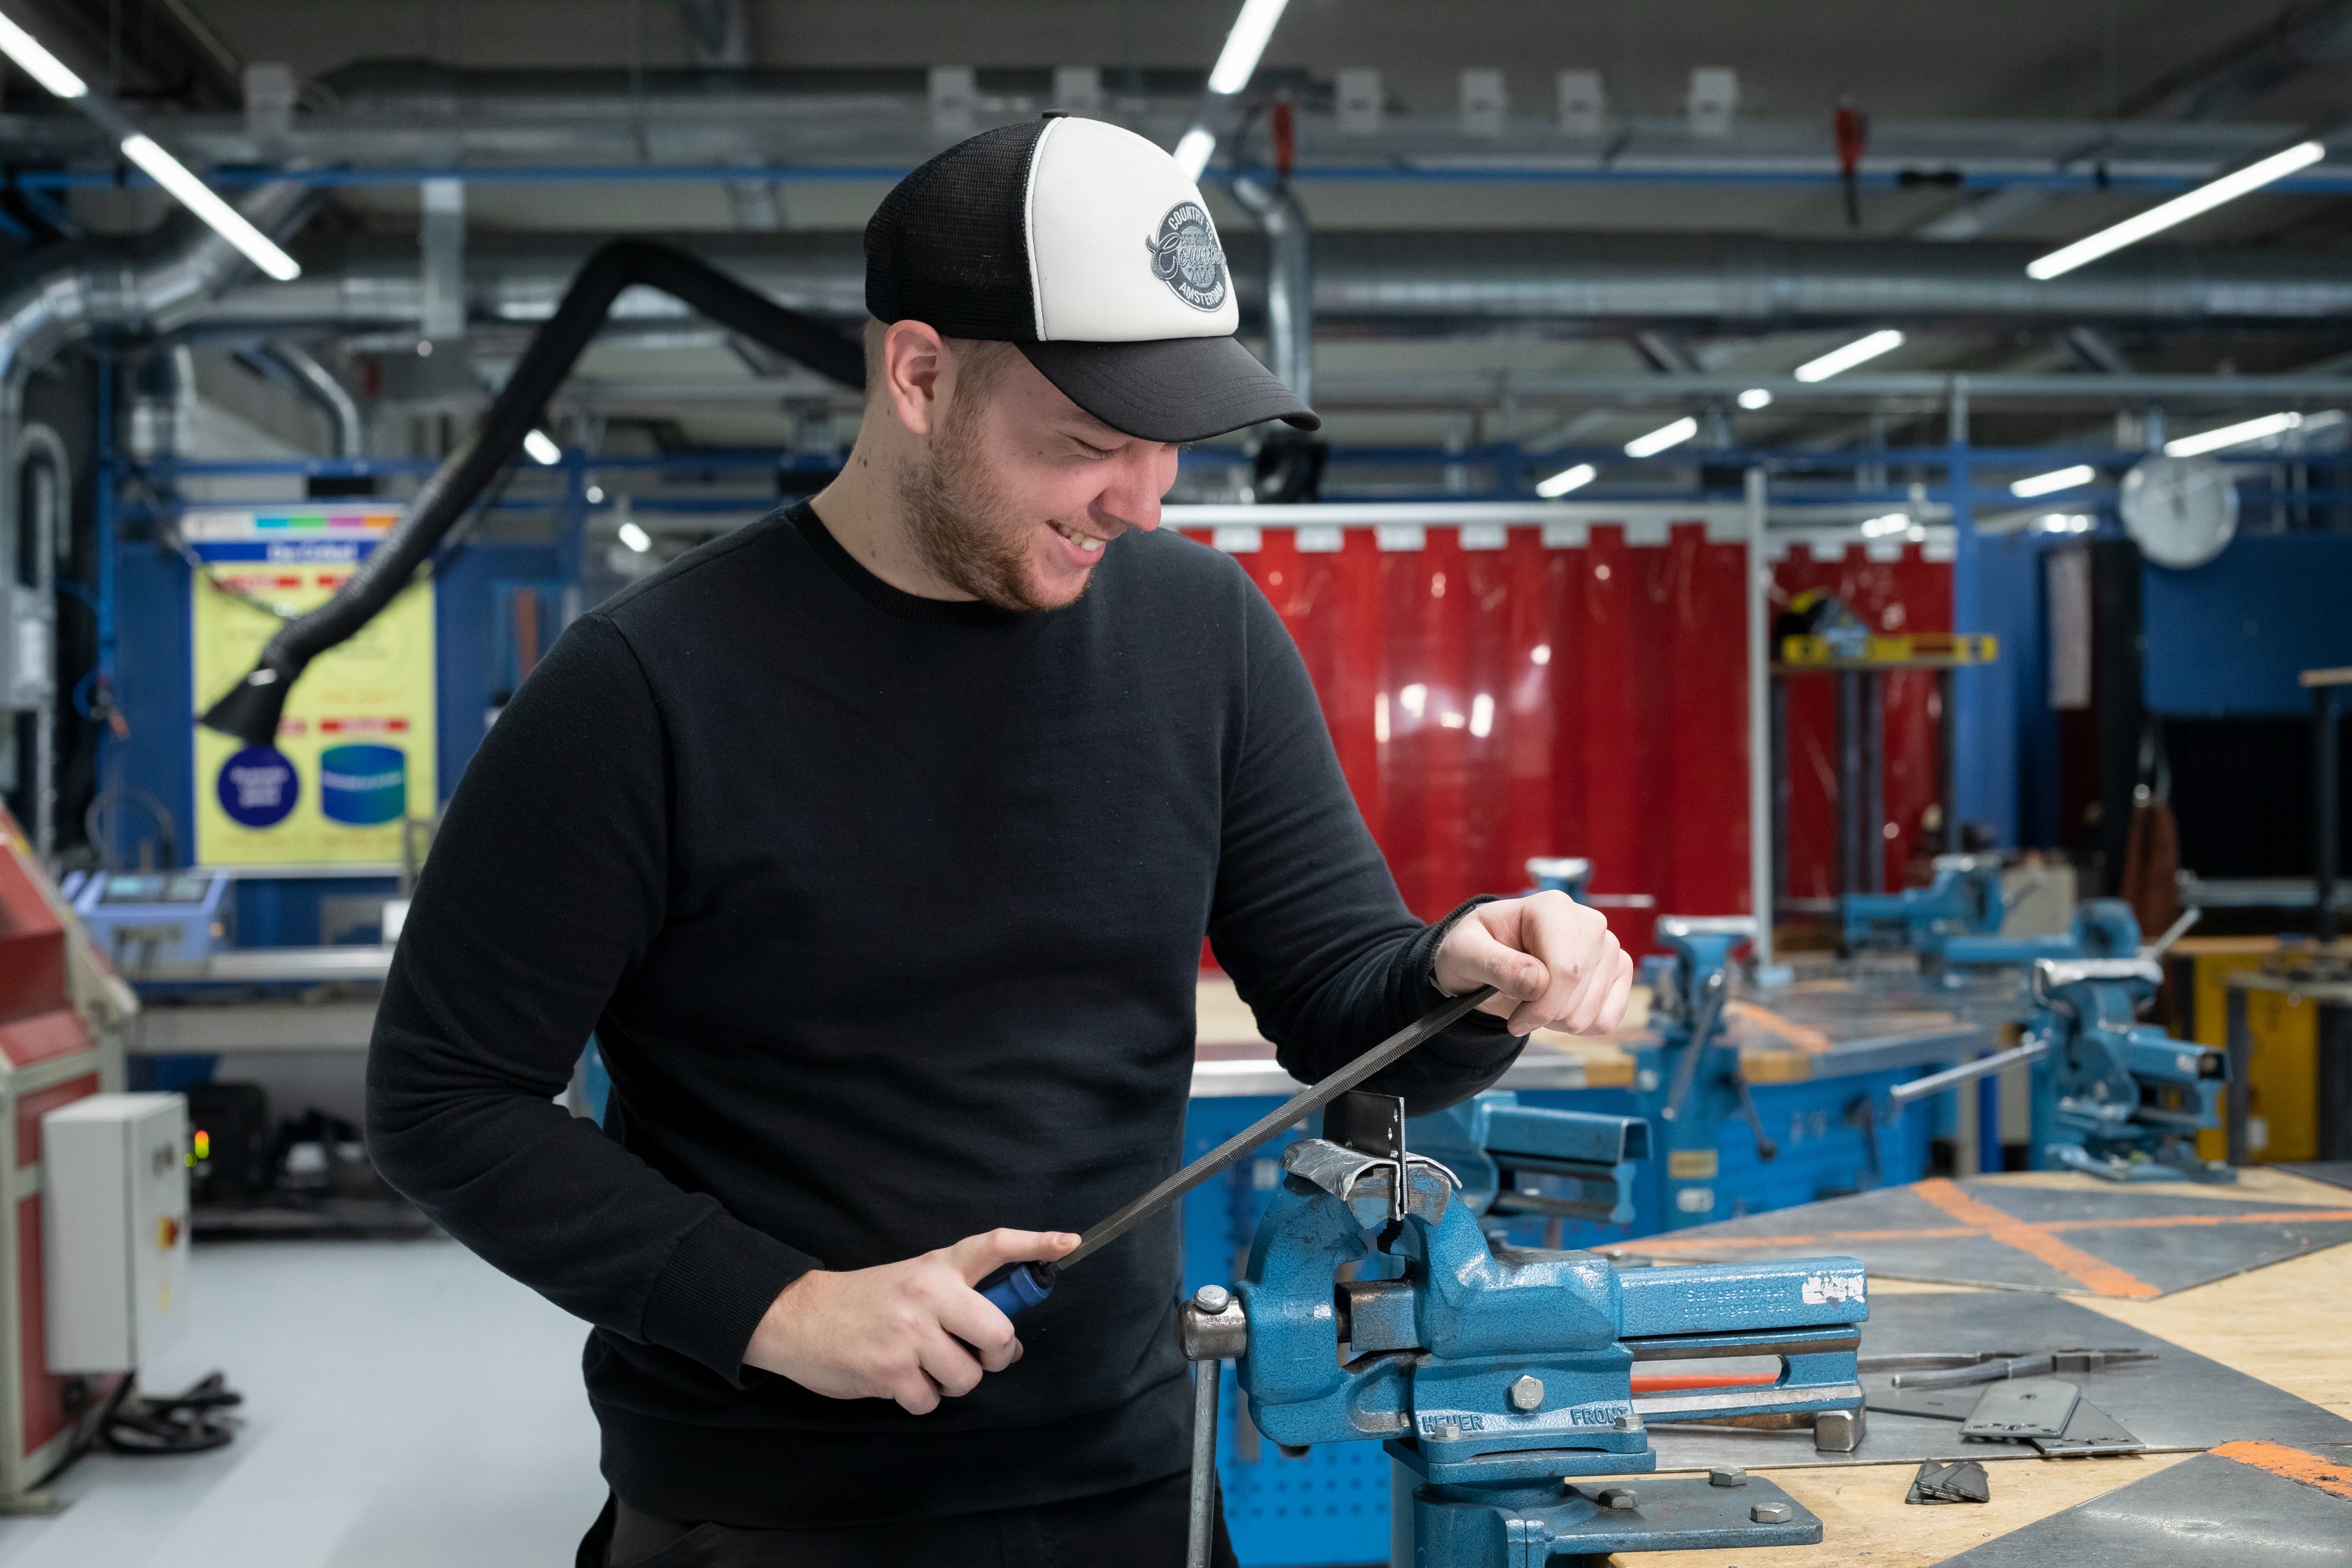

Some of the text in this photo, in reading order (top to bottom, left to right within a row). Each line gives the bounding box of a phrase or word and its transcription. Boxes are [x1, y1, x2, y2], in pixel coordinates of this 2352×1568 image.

[1168, 206, 1214, 241] COUNTRY TO
[1179, 281, 1224, 306] AMSTERDAM
[1569, 1406, 1628, 1426] FRONT
